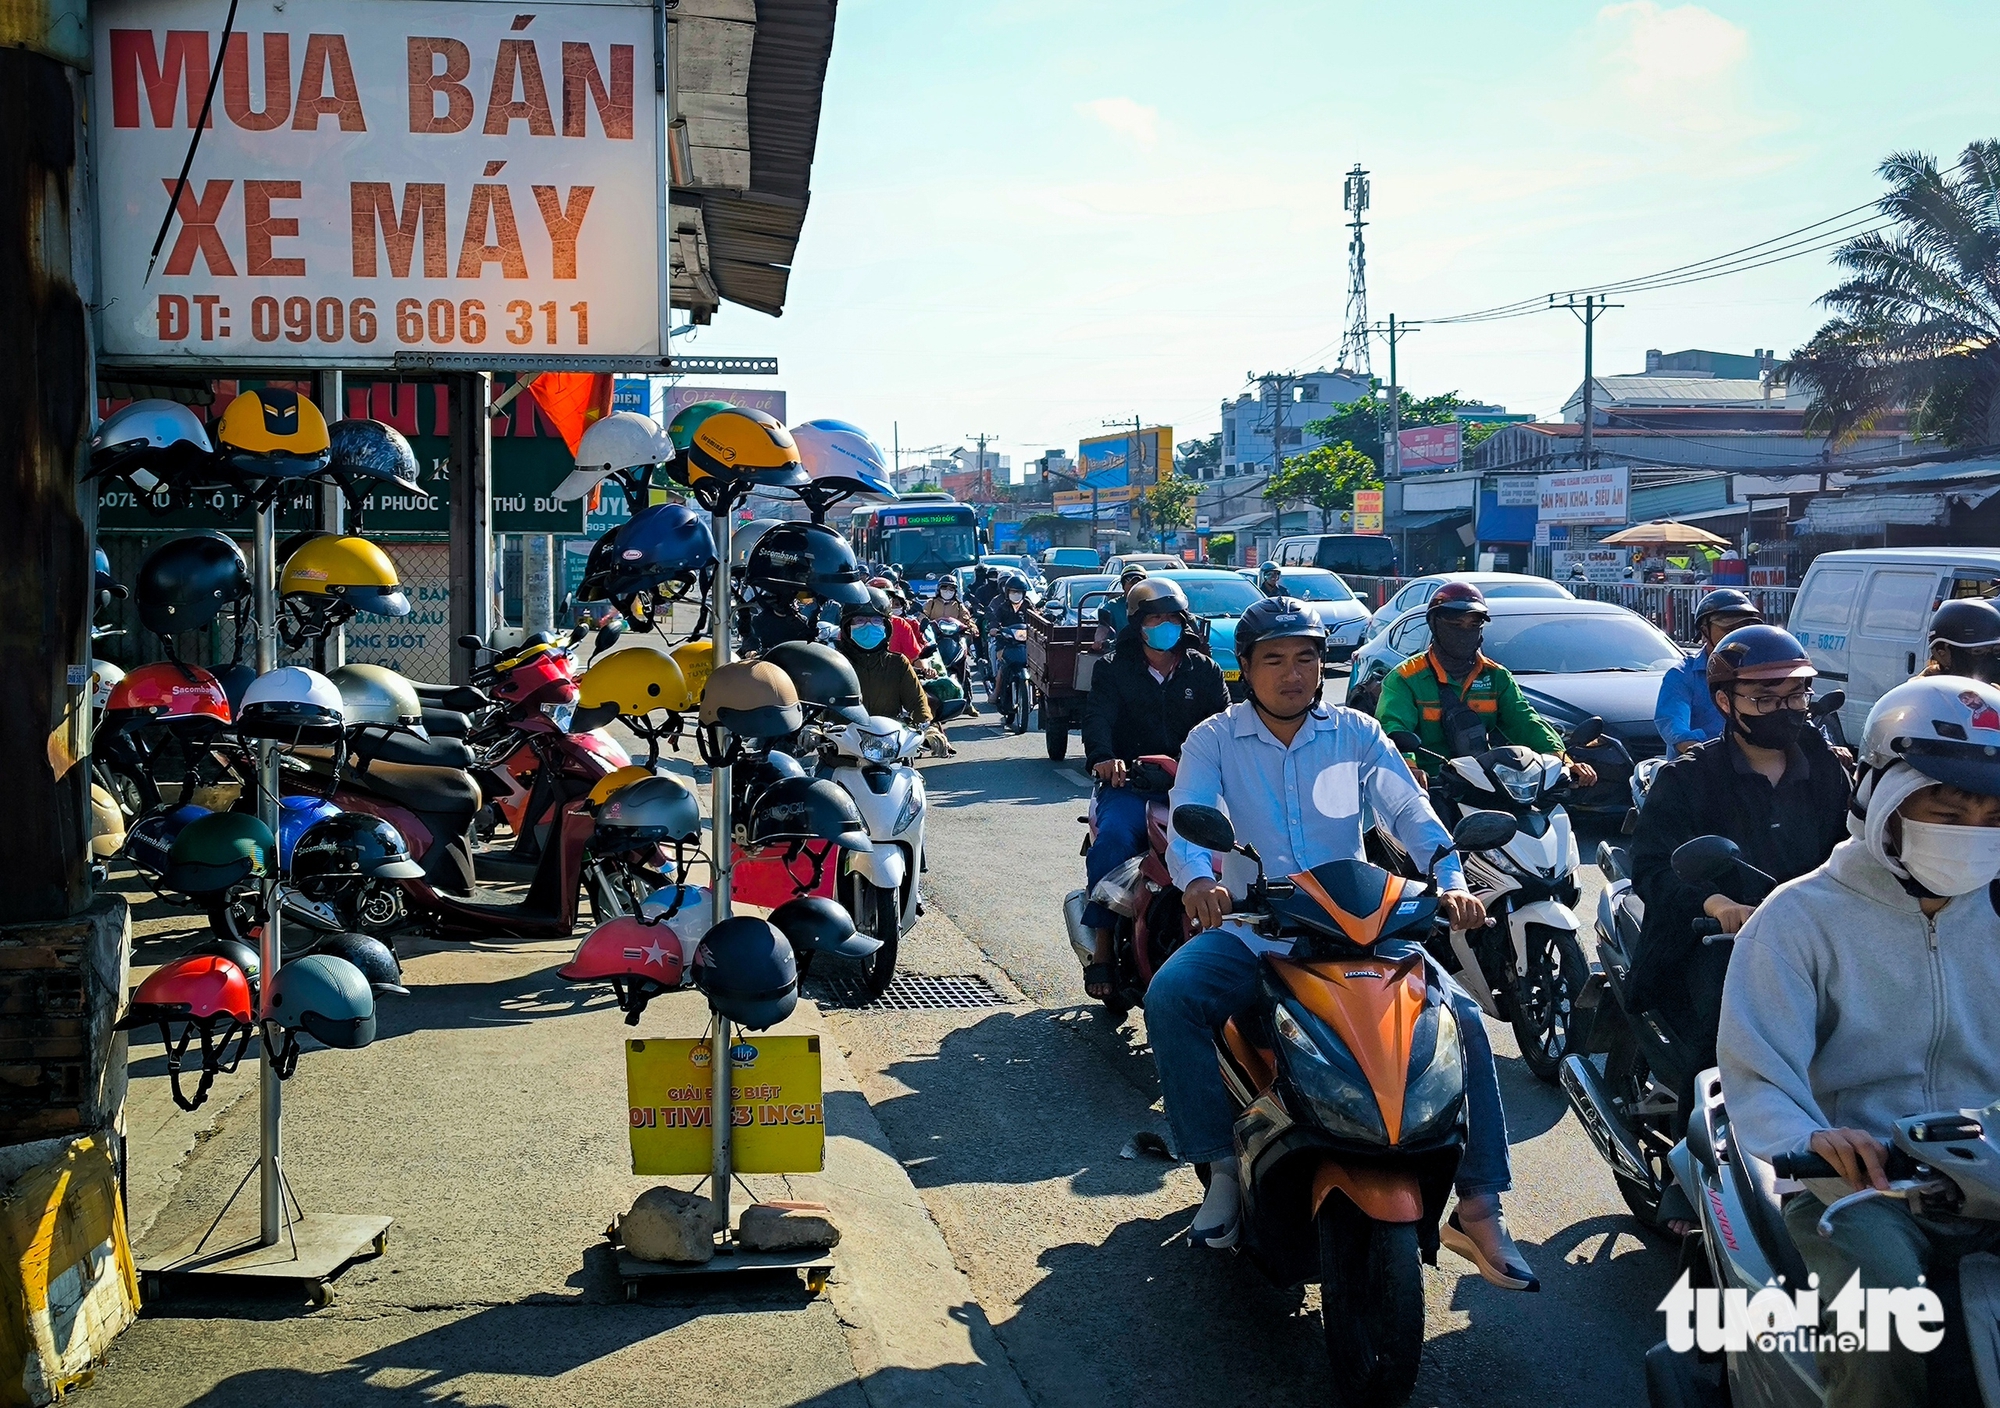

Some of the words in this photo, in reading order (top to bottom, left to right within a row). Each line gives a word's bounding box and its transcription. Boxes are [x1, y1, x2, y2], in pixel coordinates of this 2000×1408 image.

[109, 29, 367, 131] MUA
[407, 14, 635, 140] BÁN
[162, 178, 306, 277] XE
[350, 160, 595, 280] MÁY
[156, 293, 231, 341] ĐT:
[251, 295, 376, 344] 0906
[395, 297, 486, 344] 606
[505, 299, 589, 345] 311
[493, 492, 526, 512] THỦ
[1570, 491, 1588, 508] KHOA
[759, 547, 799, 561] Sacombank
[1818, 634, 1846, 650] 58277
[761, 801, 805, 821] GUCCI
[134, 829, 171, 851] Sacombank
[298, 840, 338, 856] Sacombank
[667, 1083, 701, 1100] GIẢI
[744, 1083, 782, 1102] BIỆT
[629, 1107, 657, 1128] 01
[758, 1104, 823, 1127] INCH
[1707, 1188, 1741, 1251] VISION
